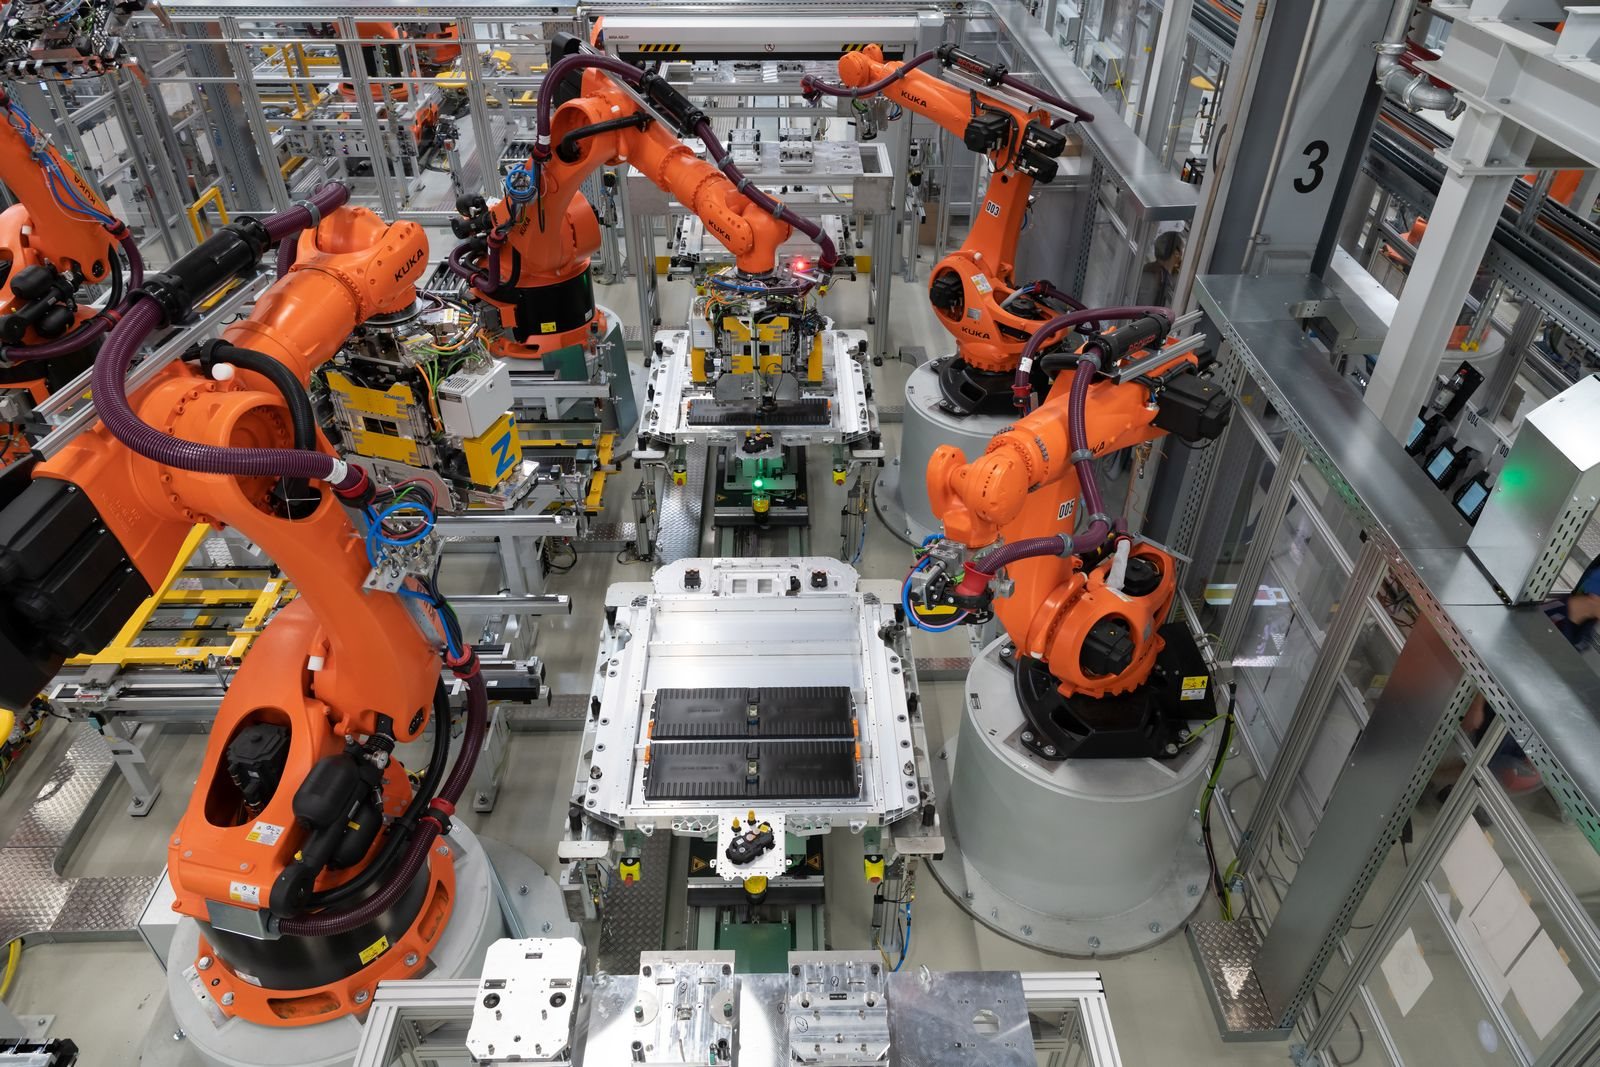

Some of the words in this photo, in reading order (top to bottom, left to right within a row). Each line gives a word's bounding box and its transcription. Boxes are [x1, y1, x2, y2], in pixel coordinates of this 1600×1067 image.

[901, 90, 927, 108] KUKA
[1293, 140, 1329, 193] 3
[986, 201, 1000, 216] 003
[708, 219, 731, 241] KUKA
[394, 248, 424, 282] KUKA
[961, 326, 991, 340] KUKA
[1467, 411, 1480, 428] 004
[1500, 444, 1510, 459] 00
[1058, 499, 1075, 518] 005
